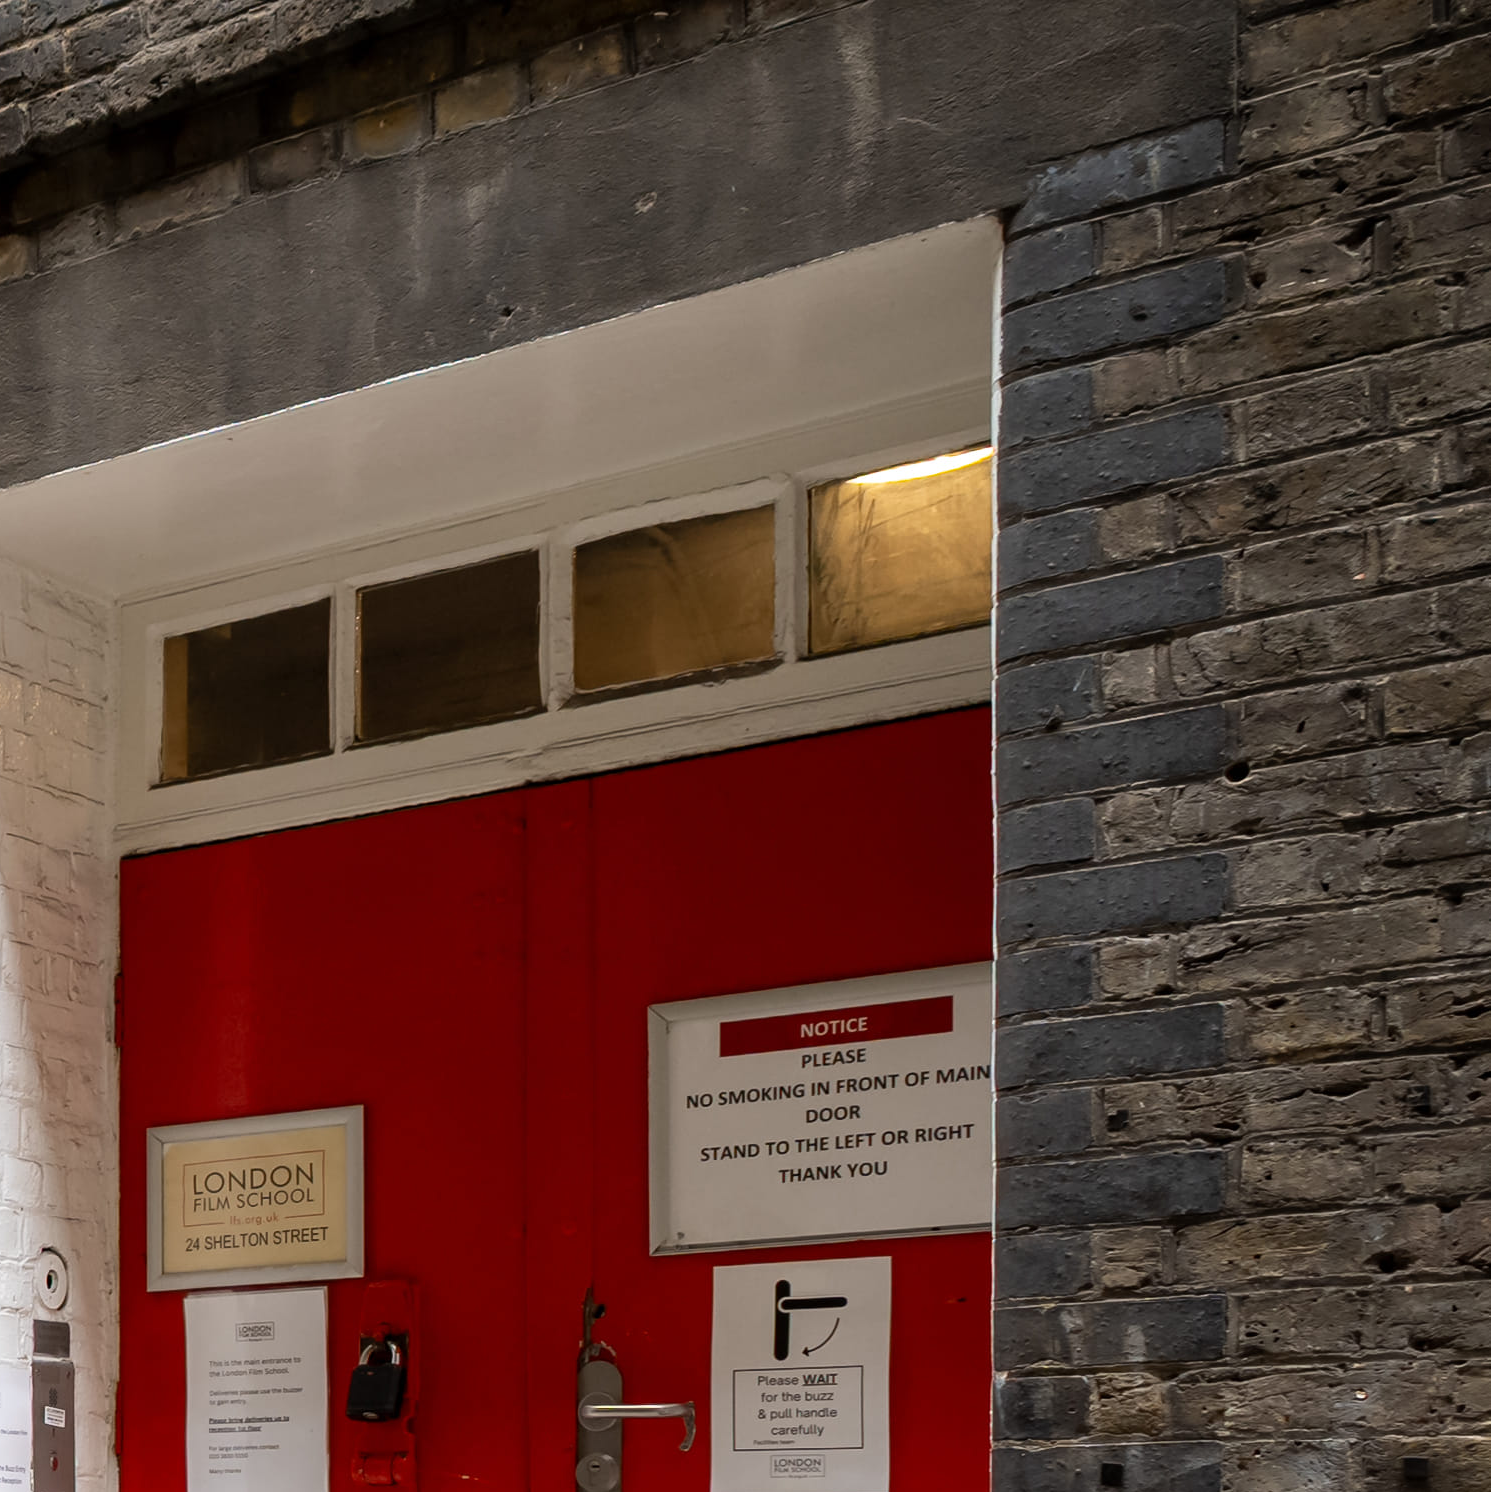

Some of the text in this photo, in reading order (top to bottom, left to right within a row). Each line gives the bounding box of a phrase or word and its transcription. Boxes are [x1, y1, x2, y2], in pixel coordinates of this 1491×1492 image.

[801, 1016, 868, 1038] NOTICE
[801, 1048, 867, 1068] PLEASE
[687, 1065, 991, 1109] NO SMOKING IN FRONT OF MAIN
[805, 1106, 861, 1124] DOOR
[700, 1124, 974, 1162] STAND TO THE LEFT OR RIGHT
[193, 1162, 313, 1195] LONDON
[779, 1161, 888, 1184] THANK YOU
[193, 1188, 315, 1212] FILM SCHOOL
[229, 1212, 279, 1226] lfs.org.uk
[185, 1226, 329, 1252] 24 SHELTON STREET
[239, 1325, 272, 1334] LONDON
[209, 1360, 223, 1368] This
[757, 1374, 838, 1386] Please WAIT
[761, 1392, 834, 1402] for the buzz
[757, 1408, 838, 1421] & pull handle
[771, 1425, 824, 1436] carefully
[774, 1458, 821, 1468] LONDON
